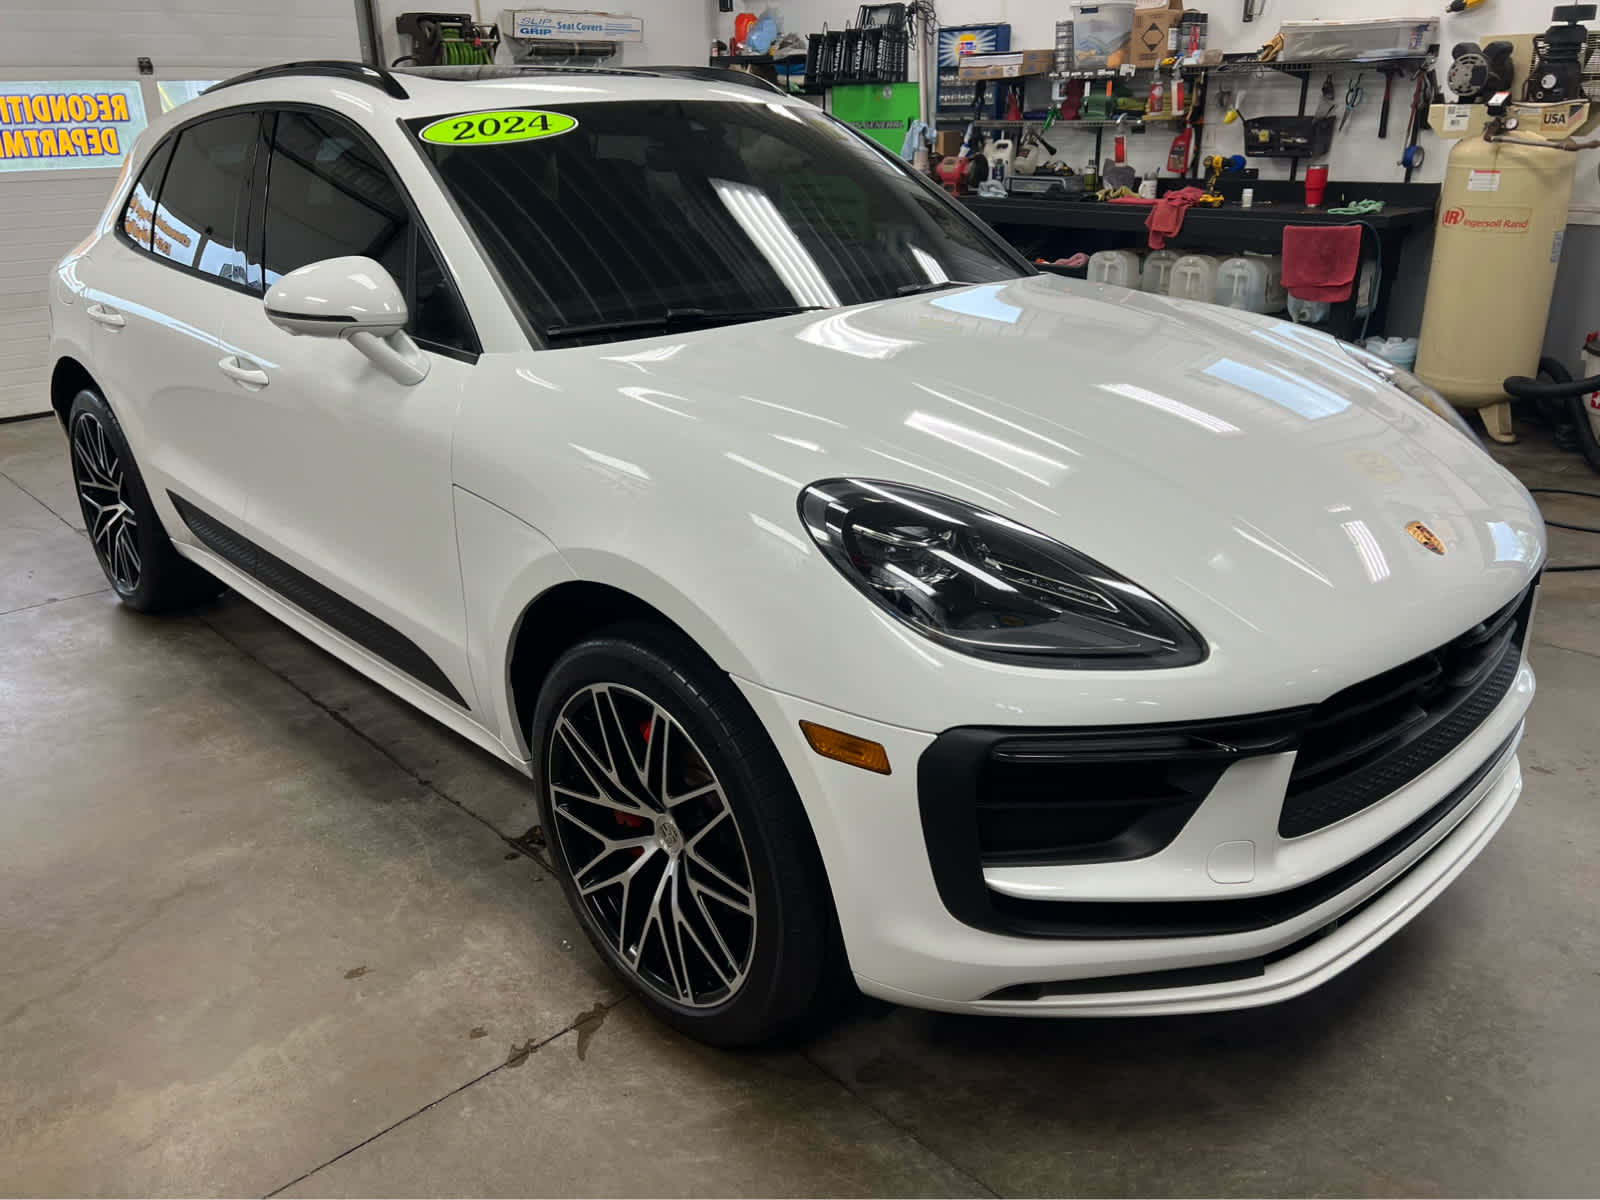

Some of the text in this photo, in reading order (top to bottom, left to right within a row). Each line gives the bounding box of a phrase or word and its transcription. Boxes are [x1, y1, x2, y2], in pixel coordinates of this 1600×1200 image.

[520, 17, 552, 25] SLIP
[557, 21, 603, 31] Seat Covers
[520, 27, 552, 35] GRIP
[1543, 113, 1566, 124] USA
[452, 114, 552, 141] 2024
[1503, 217, 1529, 228] Rand
